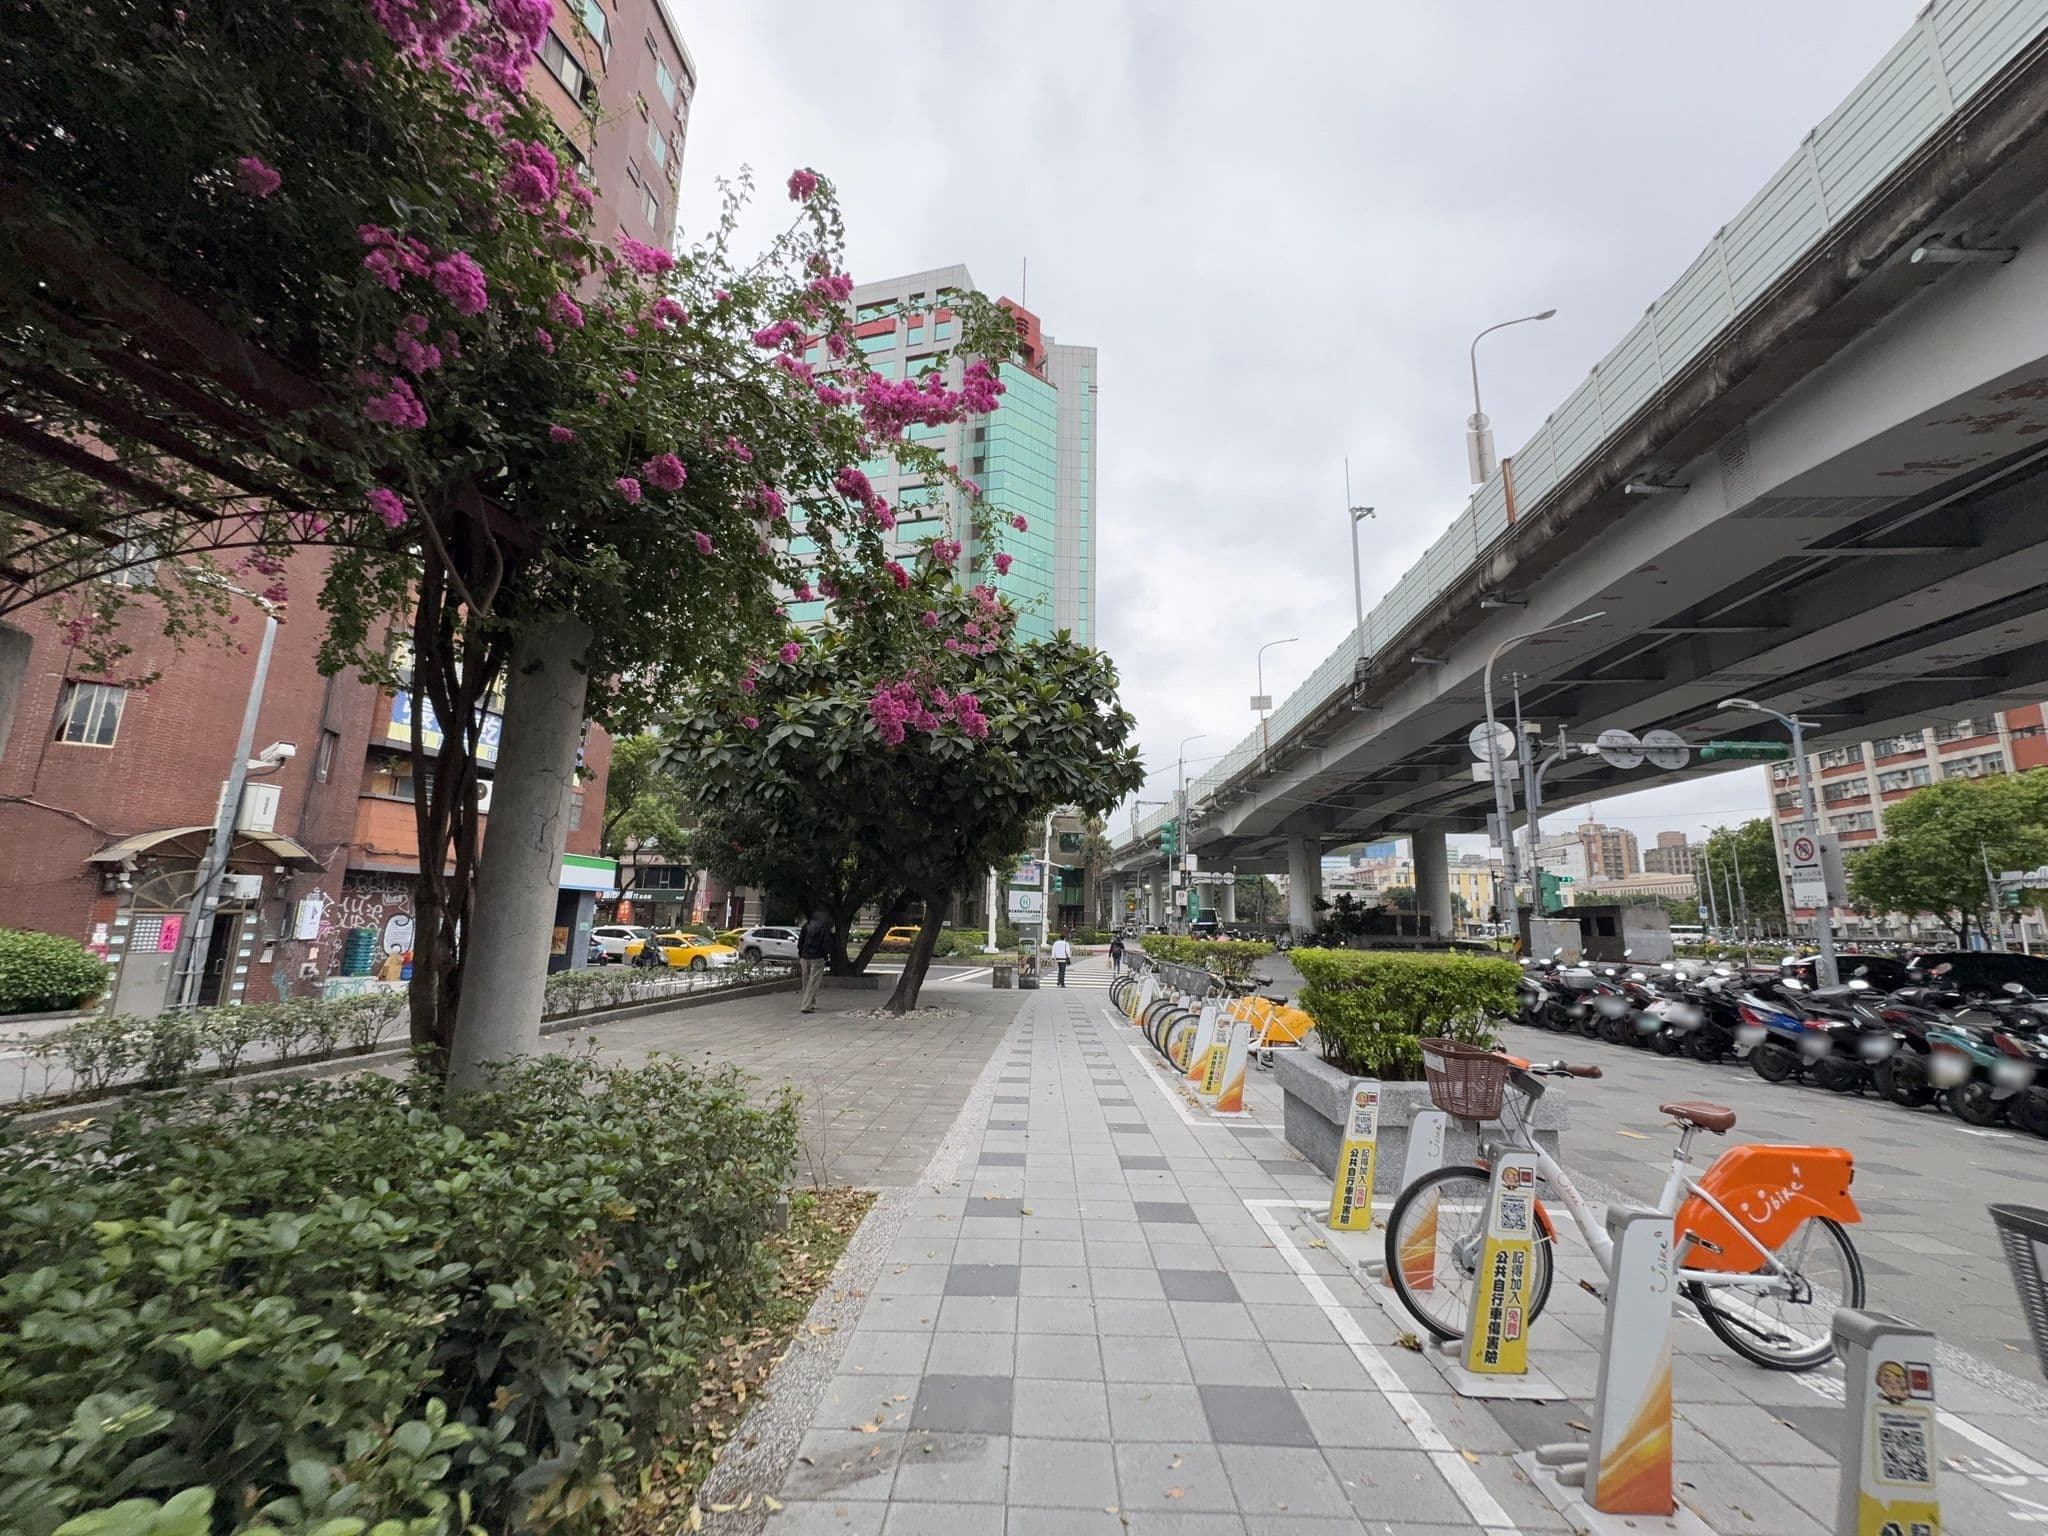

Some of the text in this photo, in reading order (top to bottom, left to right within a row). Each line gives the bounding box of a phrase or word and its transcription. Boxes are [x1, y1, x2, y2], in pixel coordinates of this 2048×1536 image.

[1484, 1250, 1509, 1364] 公共自行車傷害險
[1507, 1251, 1525, 1336] 記得加入 免費
